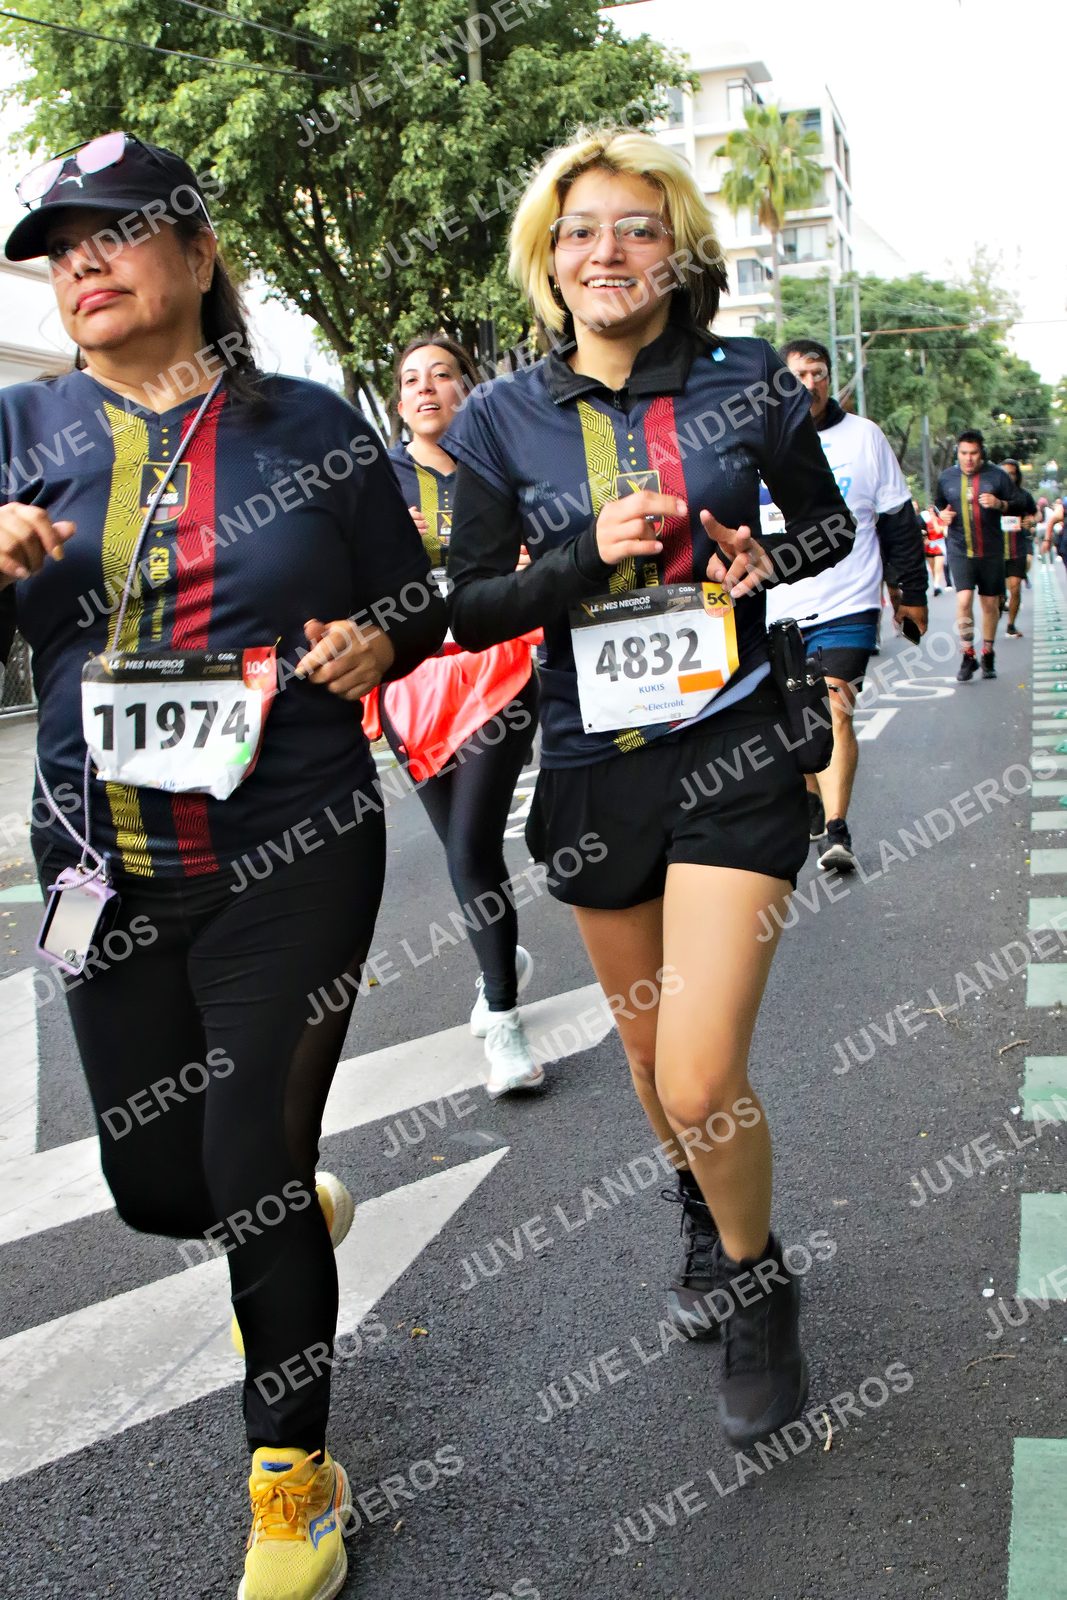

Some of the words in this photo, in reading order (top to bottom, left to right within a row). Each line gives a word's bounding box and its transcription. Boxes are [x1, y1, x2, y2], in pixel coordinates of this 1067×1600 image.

[619, 595, 651, 608] NEGROS
[596, 627, 702, 682] 4832
[639, 684, 665, 694] KUKIS
[648, 700, 684, 711] Electrolit
[93, 701, 250, 750] 11974
